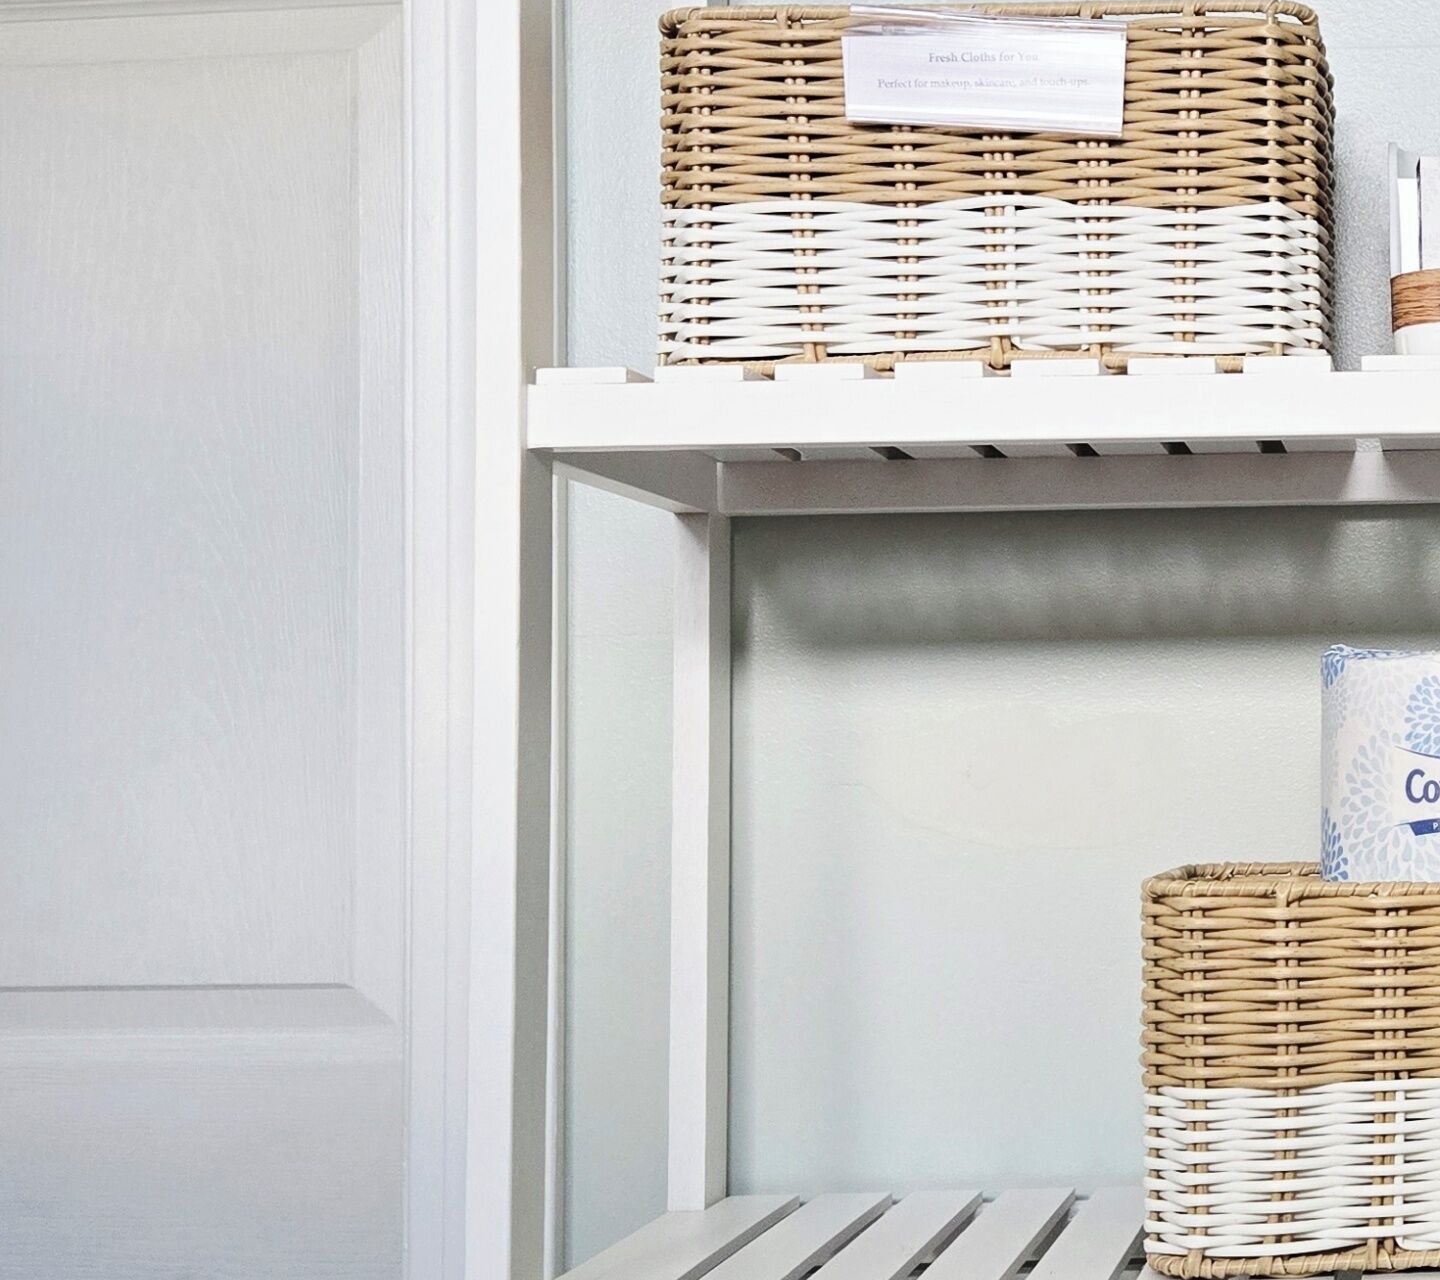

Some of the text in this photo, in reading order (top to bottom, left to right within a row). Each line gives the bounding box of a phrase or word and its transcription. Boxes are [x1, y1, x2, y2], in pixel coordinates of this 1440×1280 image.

[929, 52, 958, 63] Fresh
[960, 51, 996, 63] Cloths
[999, 51, 1015, 62] for
[914, 78, 928, 88] for
